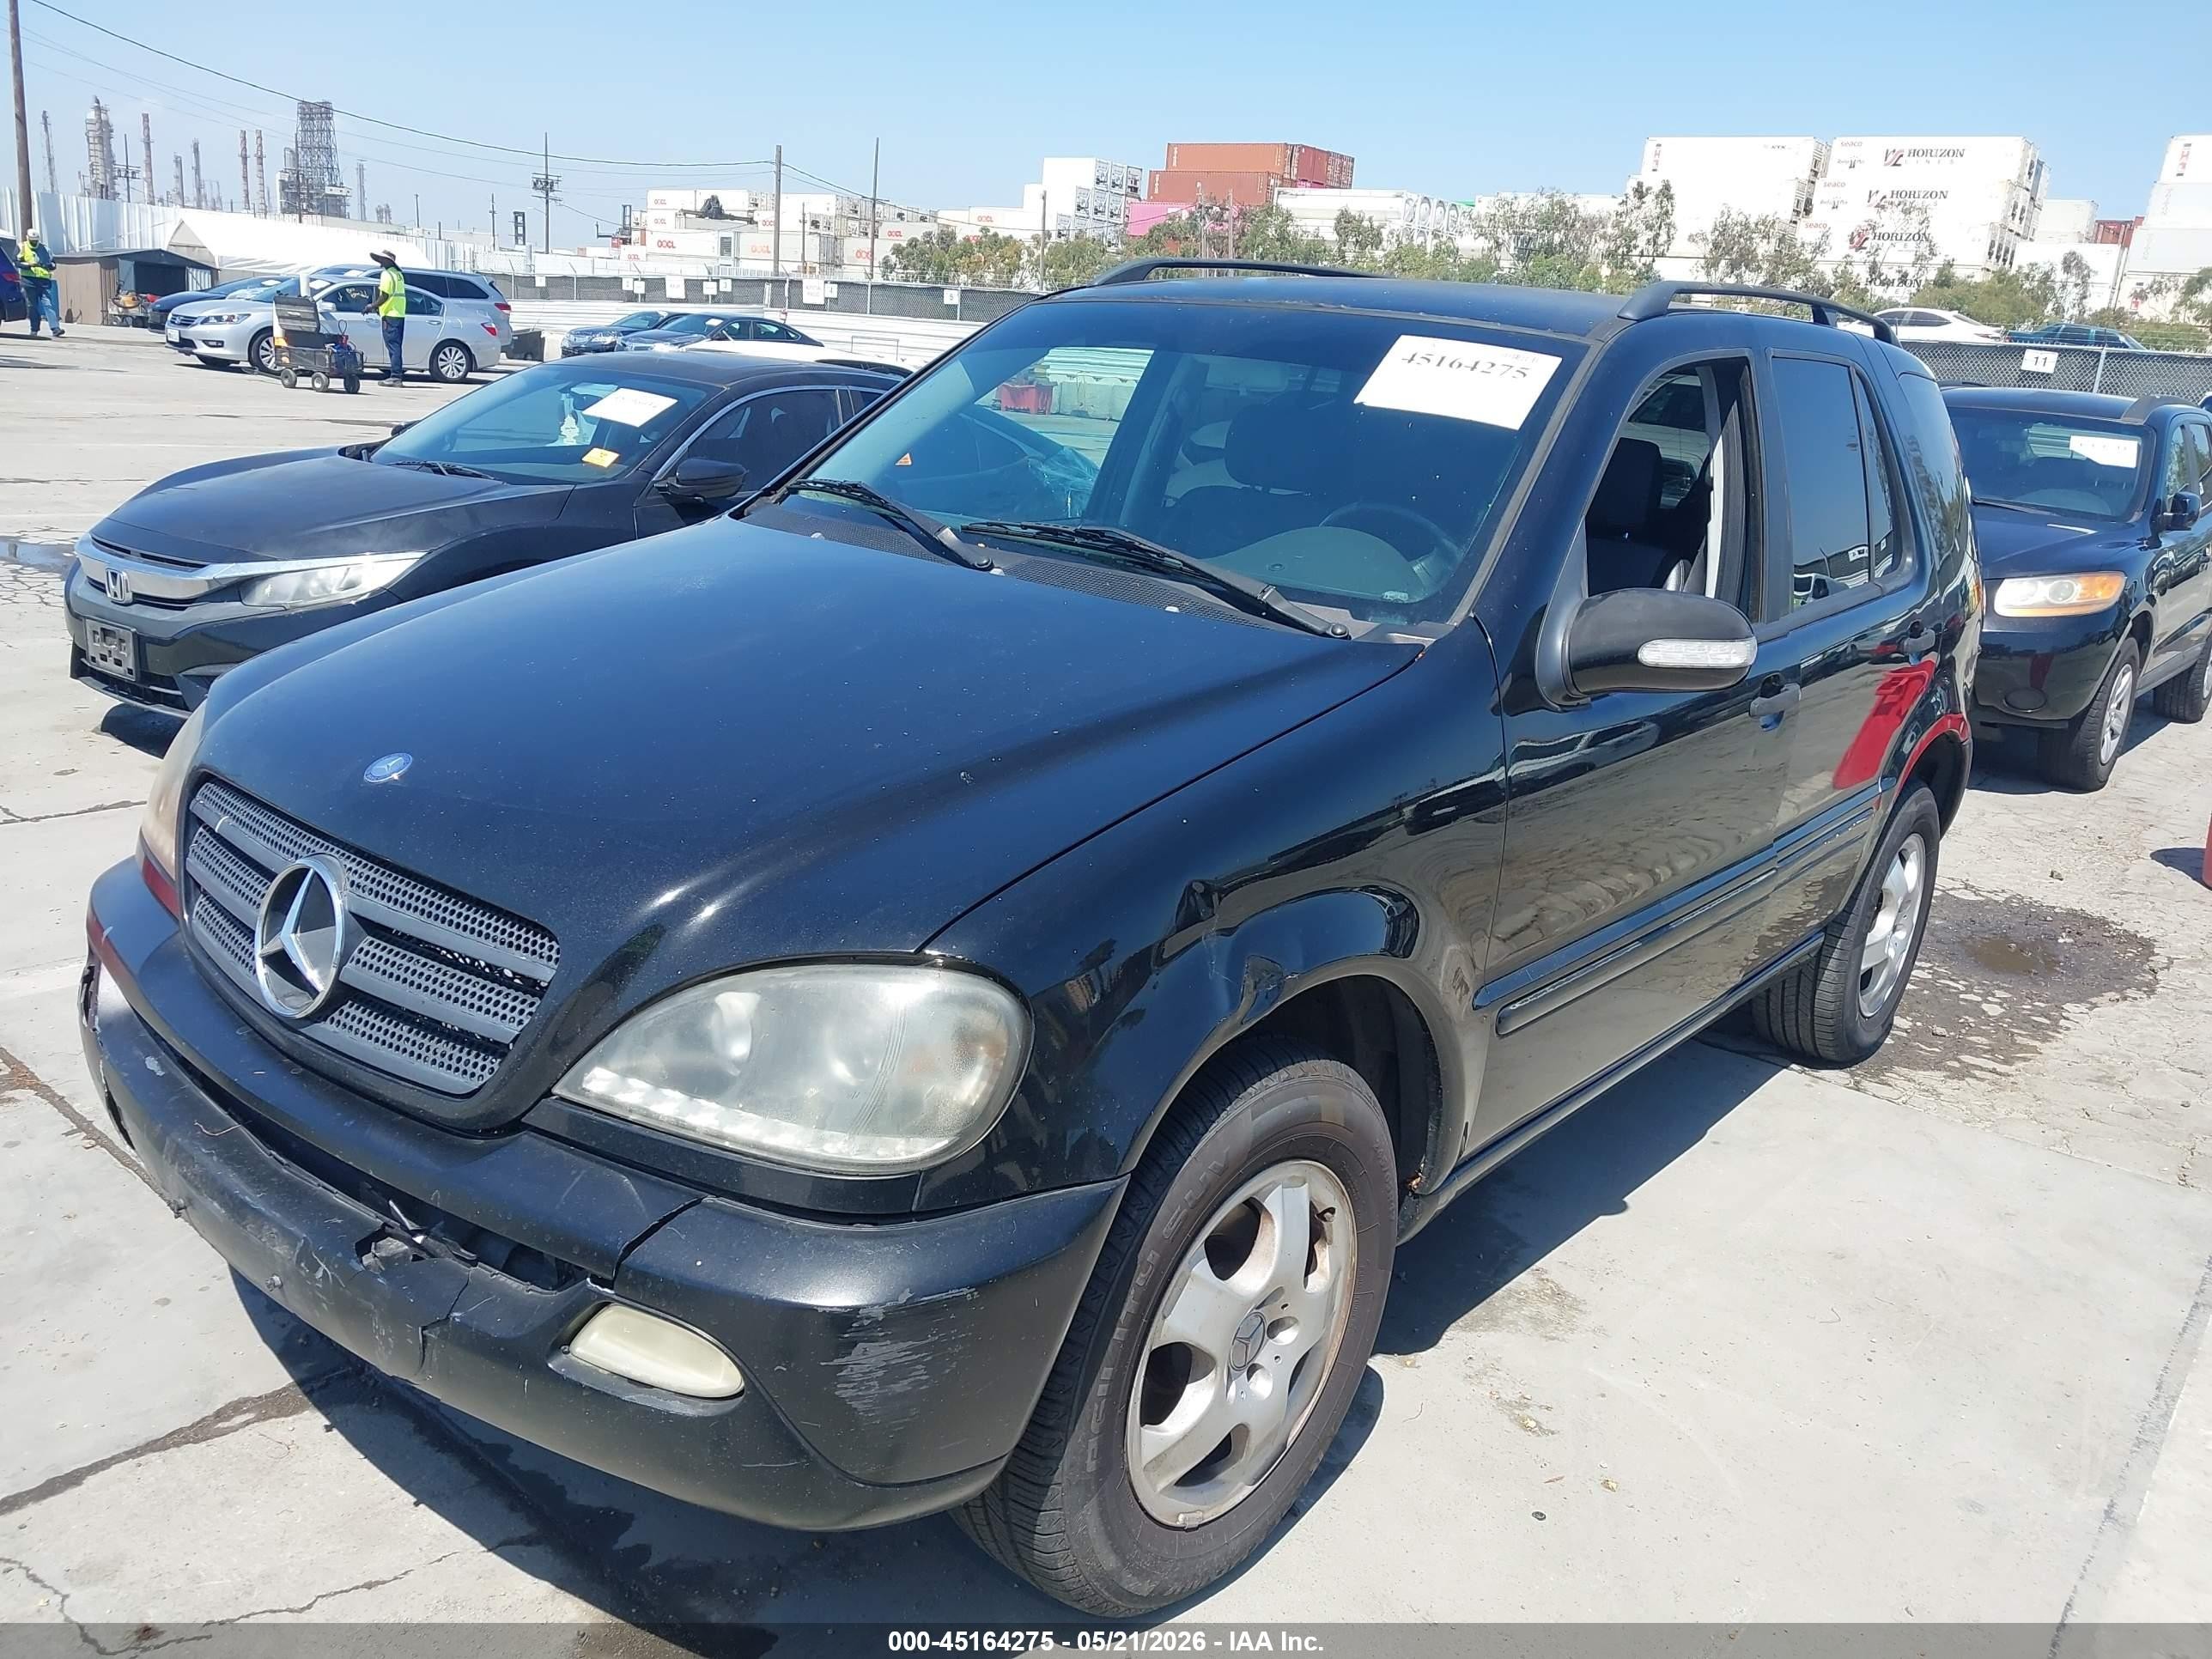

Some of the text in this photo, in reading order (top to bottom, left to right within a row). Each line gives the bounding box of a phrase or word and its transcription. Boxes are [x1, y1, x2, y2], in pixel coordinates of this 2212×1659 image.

[1907, 149, 1966, 158] HORIZON
[1890, 190, 1949, 199] HORIZON
[1873, 232, 1932, 242] HORIZON
[657, 240, 677, 249] OOCL
[750, 245, 771, 253] OOCL
[1401, 351, 1531, 379] 45164275
[2033, 356, 2048, 368] 11
